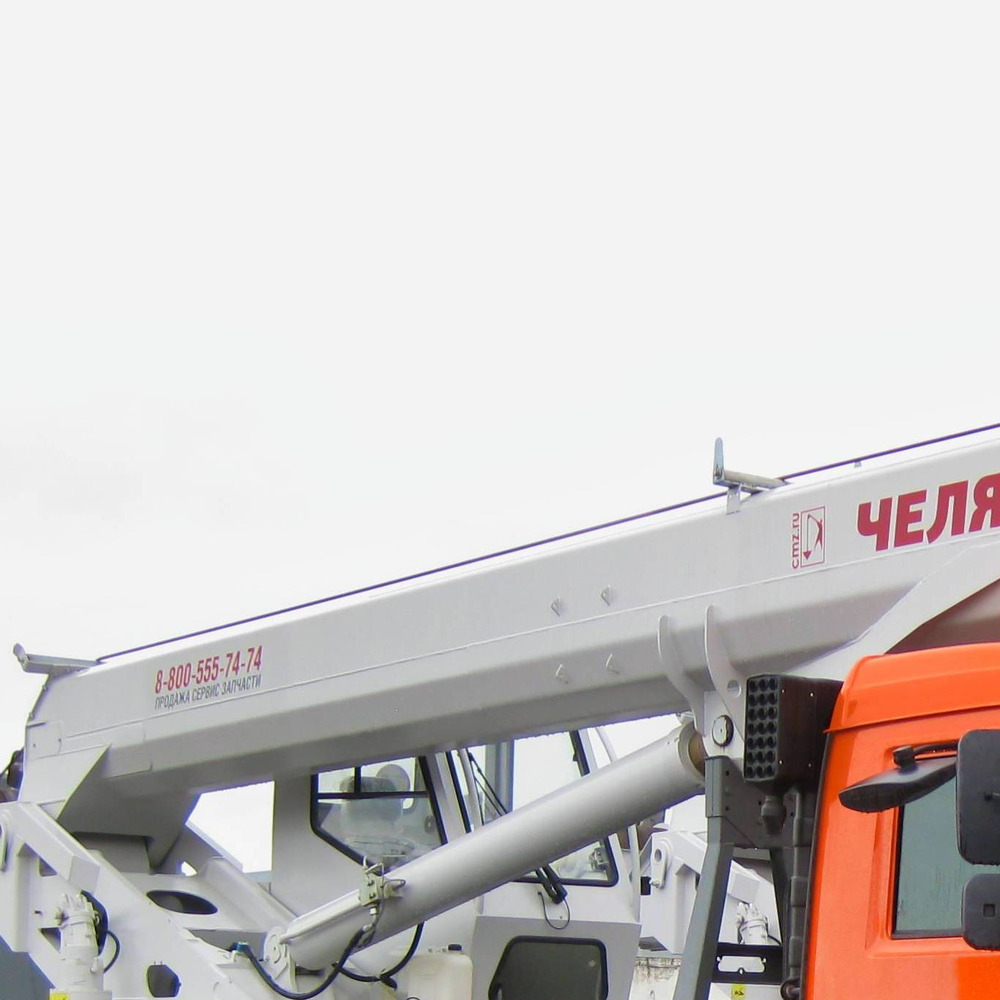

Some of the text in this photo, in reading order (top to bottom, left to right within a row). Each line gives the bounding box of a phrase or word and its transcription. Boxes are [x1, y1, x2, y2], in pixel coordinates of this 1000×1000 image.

[791, 512, 800, 570] cmz.ru
[154, 674, 262, 710] ПРОДАЖА СЕРВИС ЗАПЧАСТИ
[155, 645, 263, 694] 8-800-555-74-74
